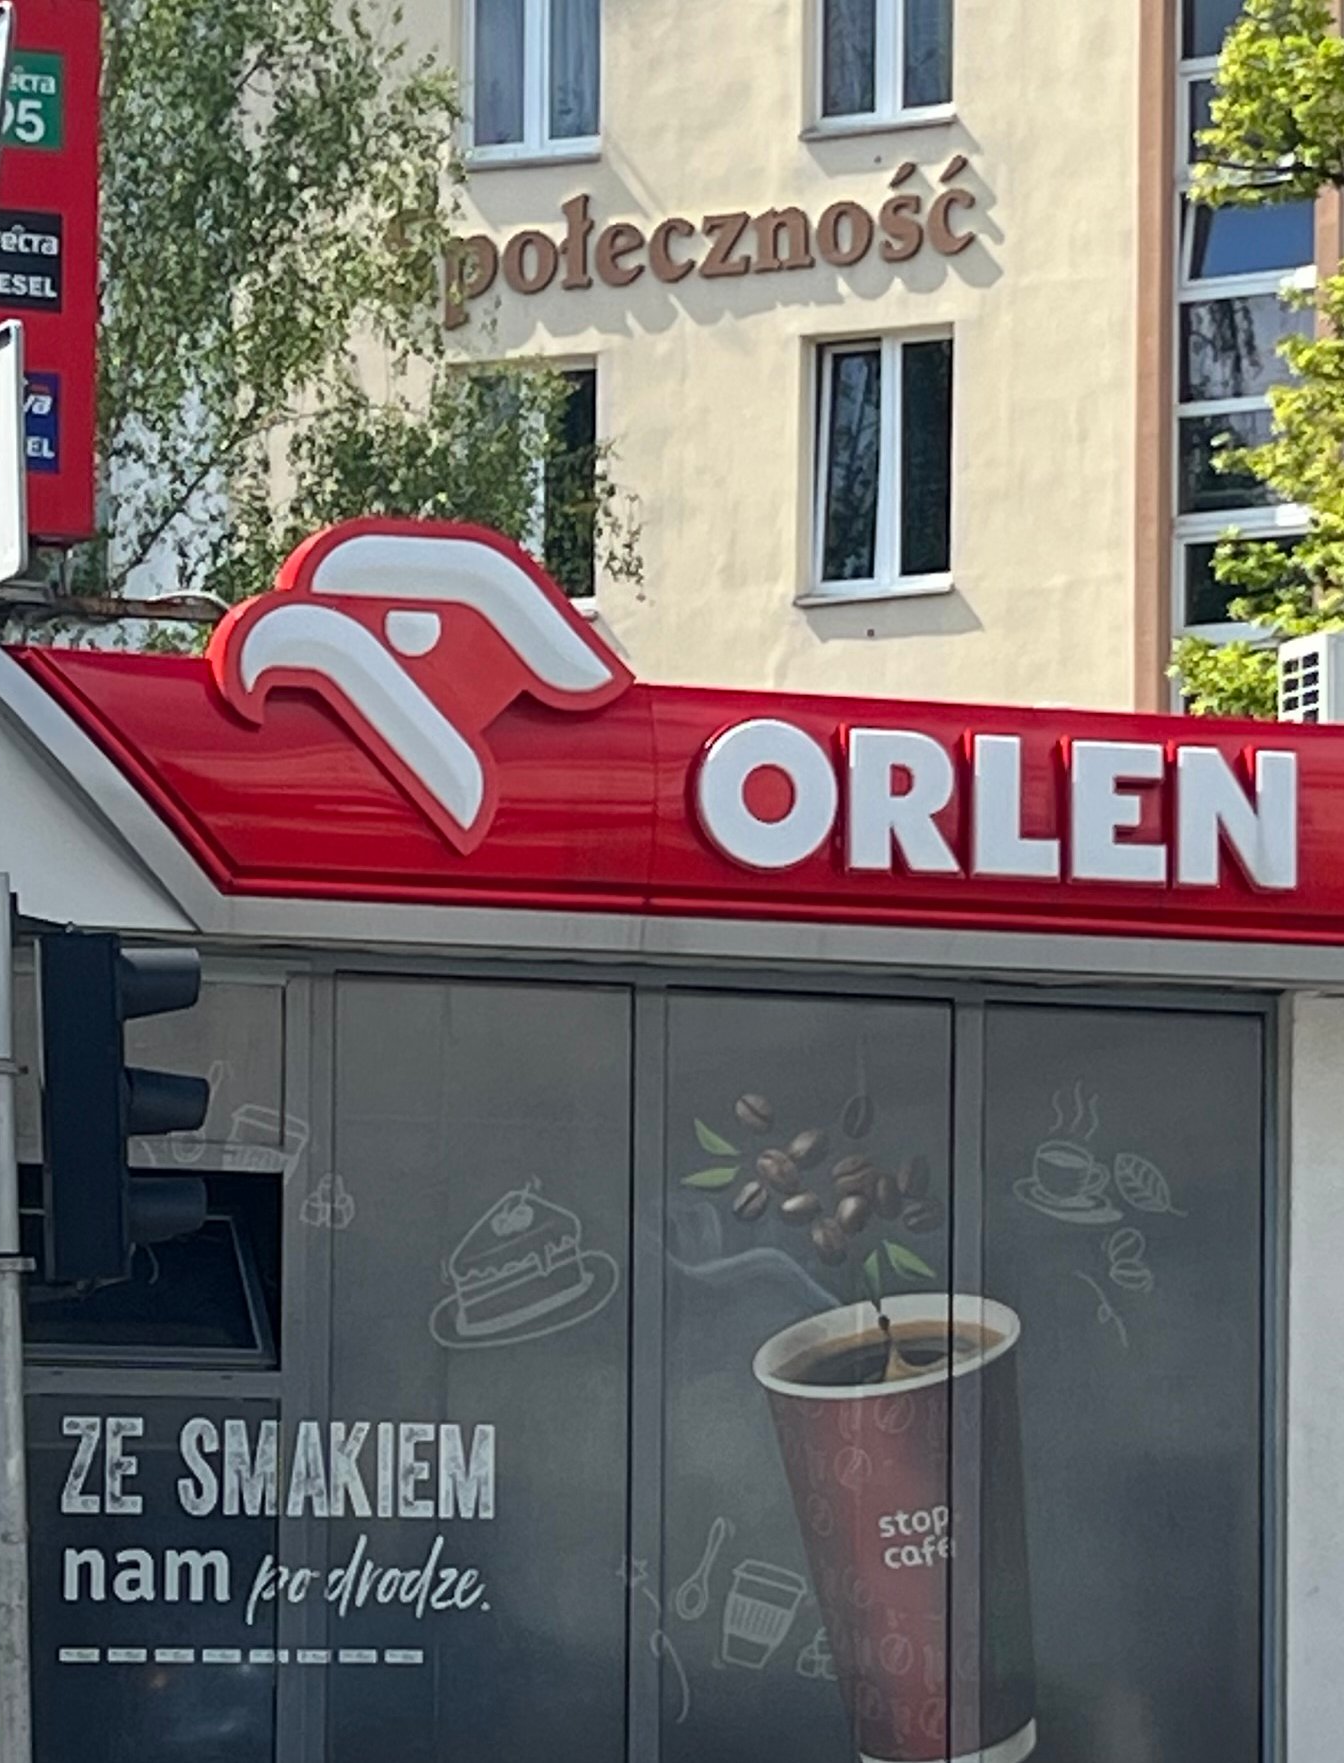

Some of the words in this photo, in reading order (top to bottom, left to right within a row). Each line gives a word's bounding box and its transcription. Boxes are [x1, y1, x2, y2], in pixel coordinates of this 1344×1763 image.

[696, 718, 1298, 892] ORLEN
[61, 1416, 144, 1514] ZE
[177, 1416, 496, 1520] SMAKIEM
[878, 1505, 949, 1538] stop
[63, 1548, 230, 1602] nam
[244, 1554, 321, 1626] po
[326, 1533, 492, 1620] drodze.
